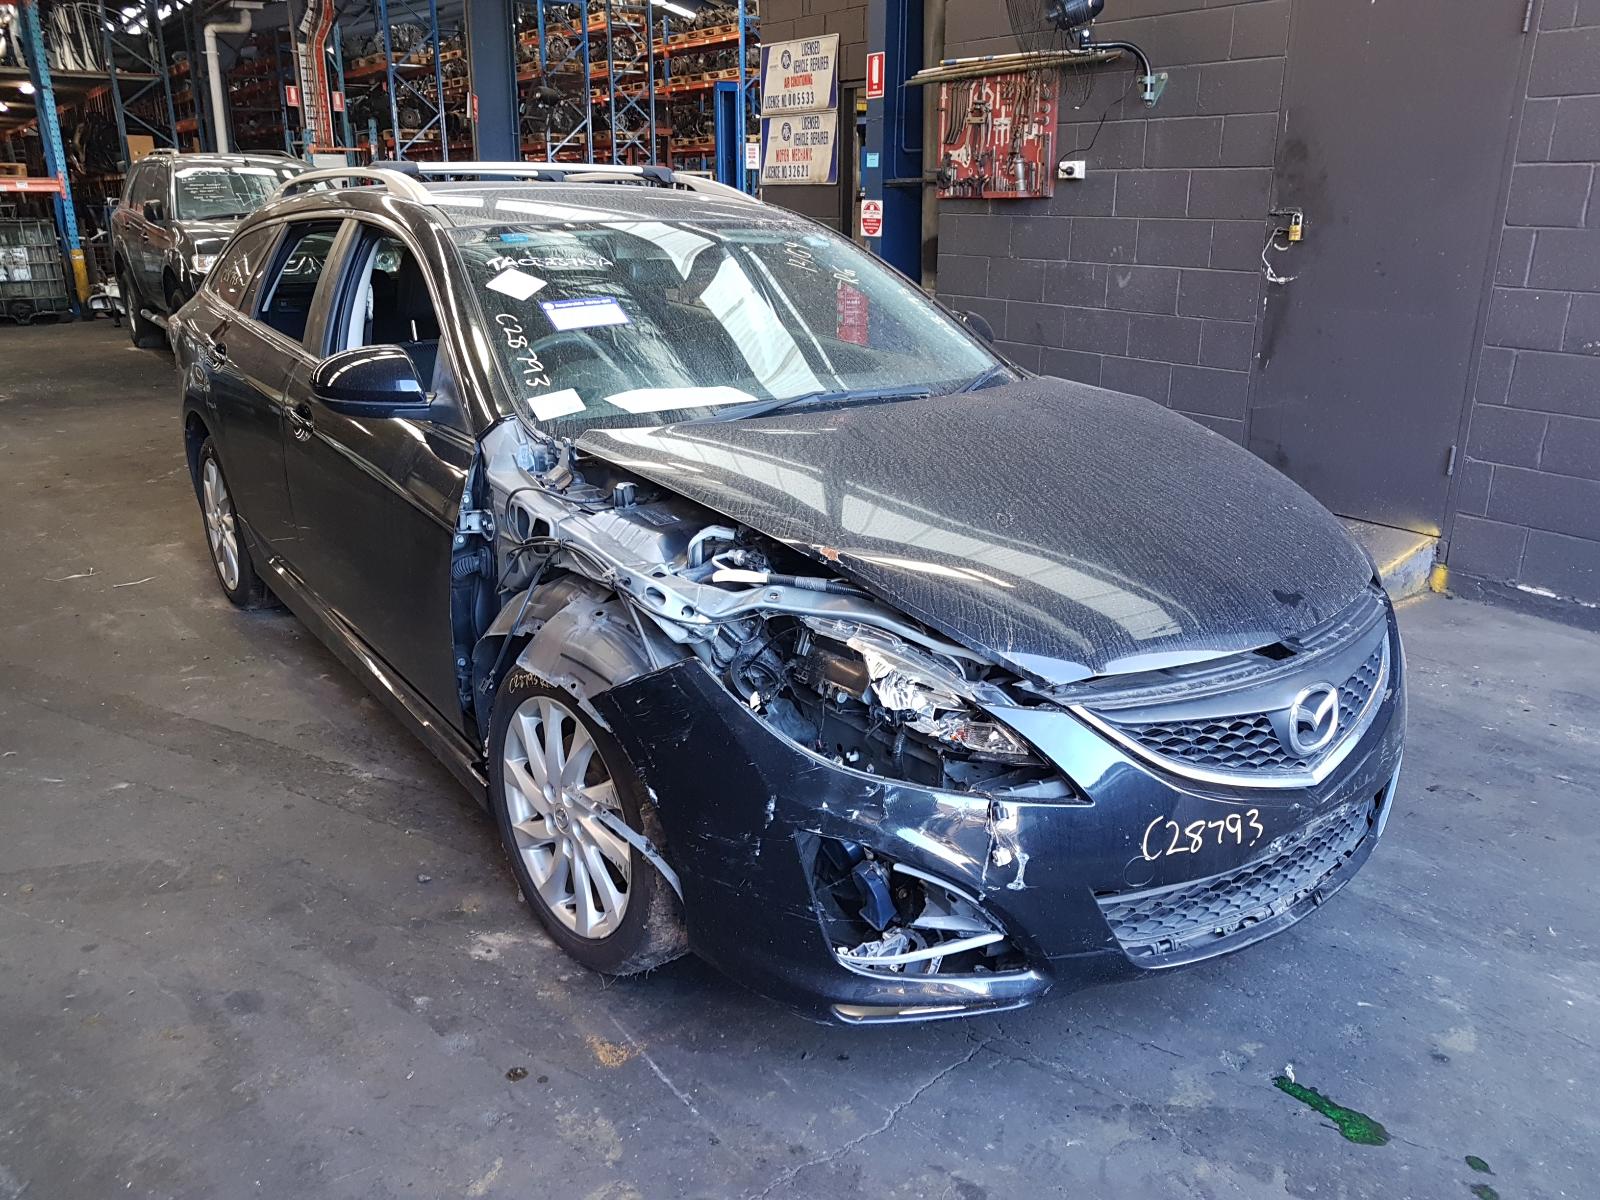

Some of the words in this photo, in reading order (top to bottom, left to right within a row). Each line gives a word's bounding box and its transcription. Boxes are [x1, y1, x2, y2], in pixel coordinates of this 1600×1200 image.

[801, 41, 820, 56] LICENSED
[793, 58, 809, 74] VEHICLE
[810, 56, 829, 71] REPAIRER
[801, 115, 820, 130] LICENSED
[793, 132, 809, 146] VEHICLE
[810, 131, 829, 145] REPAIRER
[775, 148, 789, 162] MOTOR
[791, 147, 812, 161] MECHANIC
[495, 313, 551, 387] C28793
[1142, 808, 1264, 861] C28793
